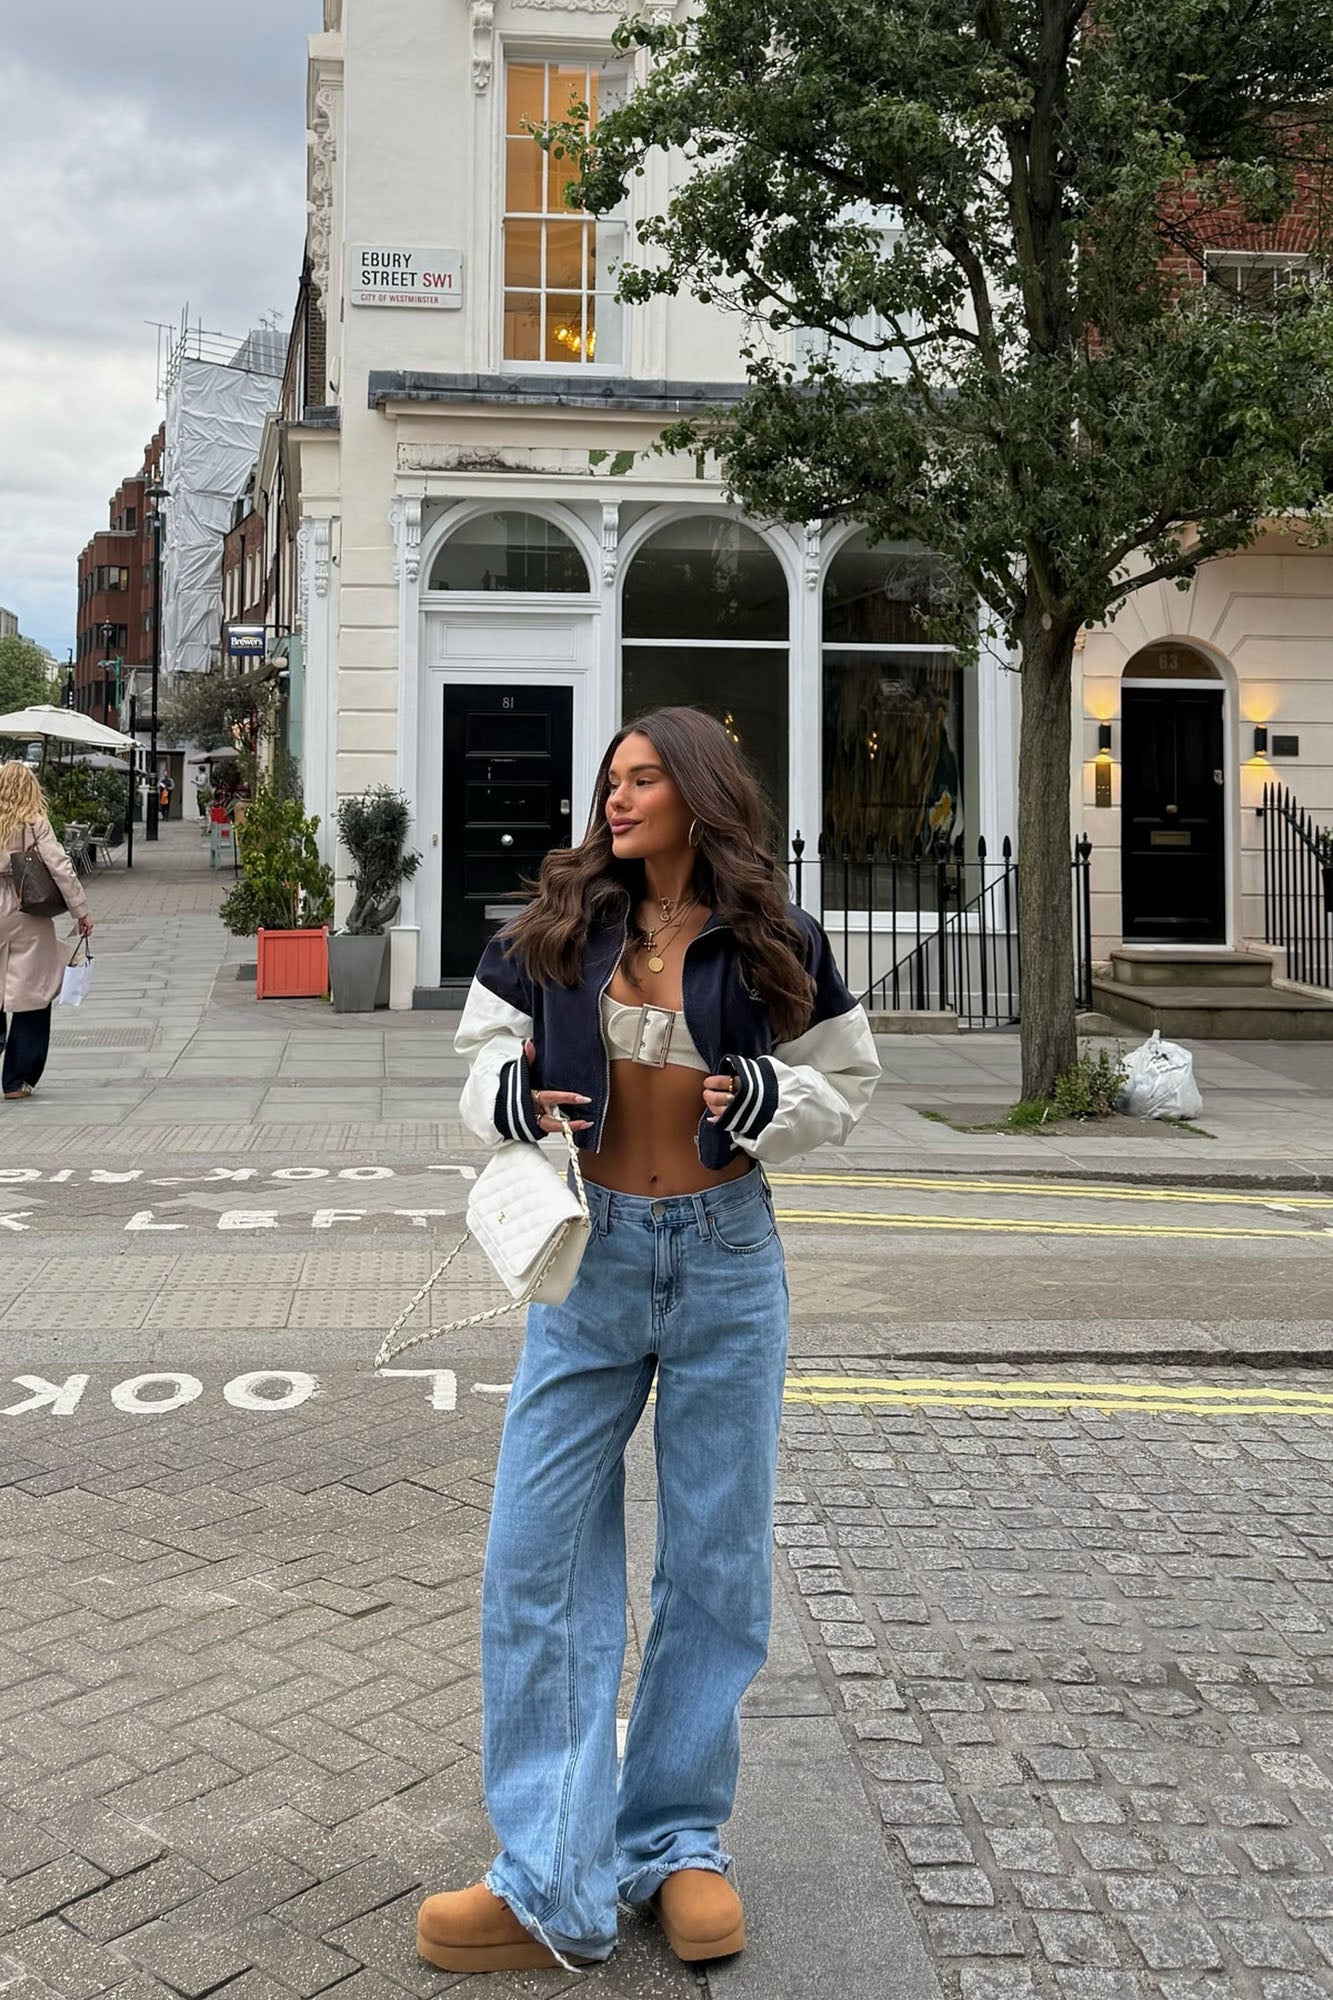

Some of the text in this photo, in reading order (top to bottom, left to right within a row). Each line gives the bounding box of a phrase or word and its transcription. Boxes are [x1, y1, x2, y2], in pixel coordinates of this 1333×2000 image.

[361, 252, 412, 268] EBURY
[361, 270, 453, 288] STREET SW1
[360, 293, 439, 304] CITY OF WESTMINSTER
[230, 636, 263, 647] Brewers
[1158, 653, 1179, 671] 83
[502, 696, 514, 709] 81
[203, 1164, 477, 1182] LOOK
[124, 1209, 446, 1231] LEFT
[0, 1368, 457, 1415] LOOK
